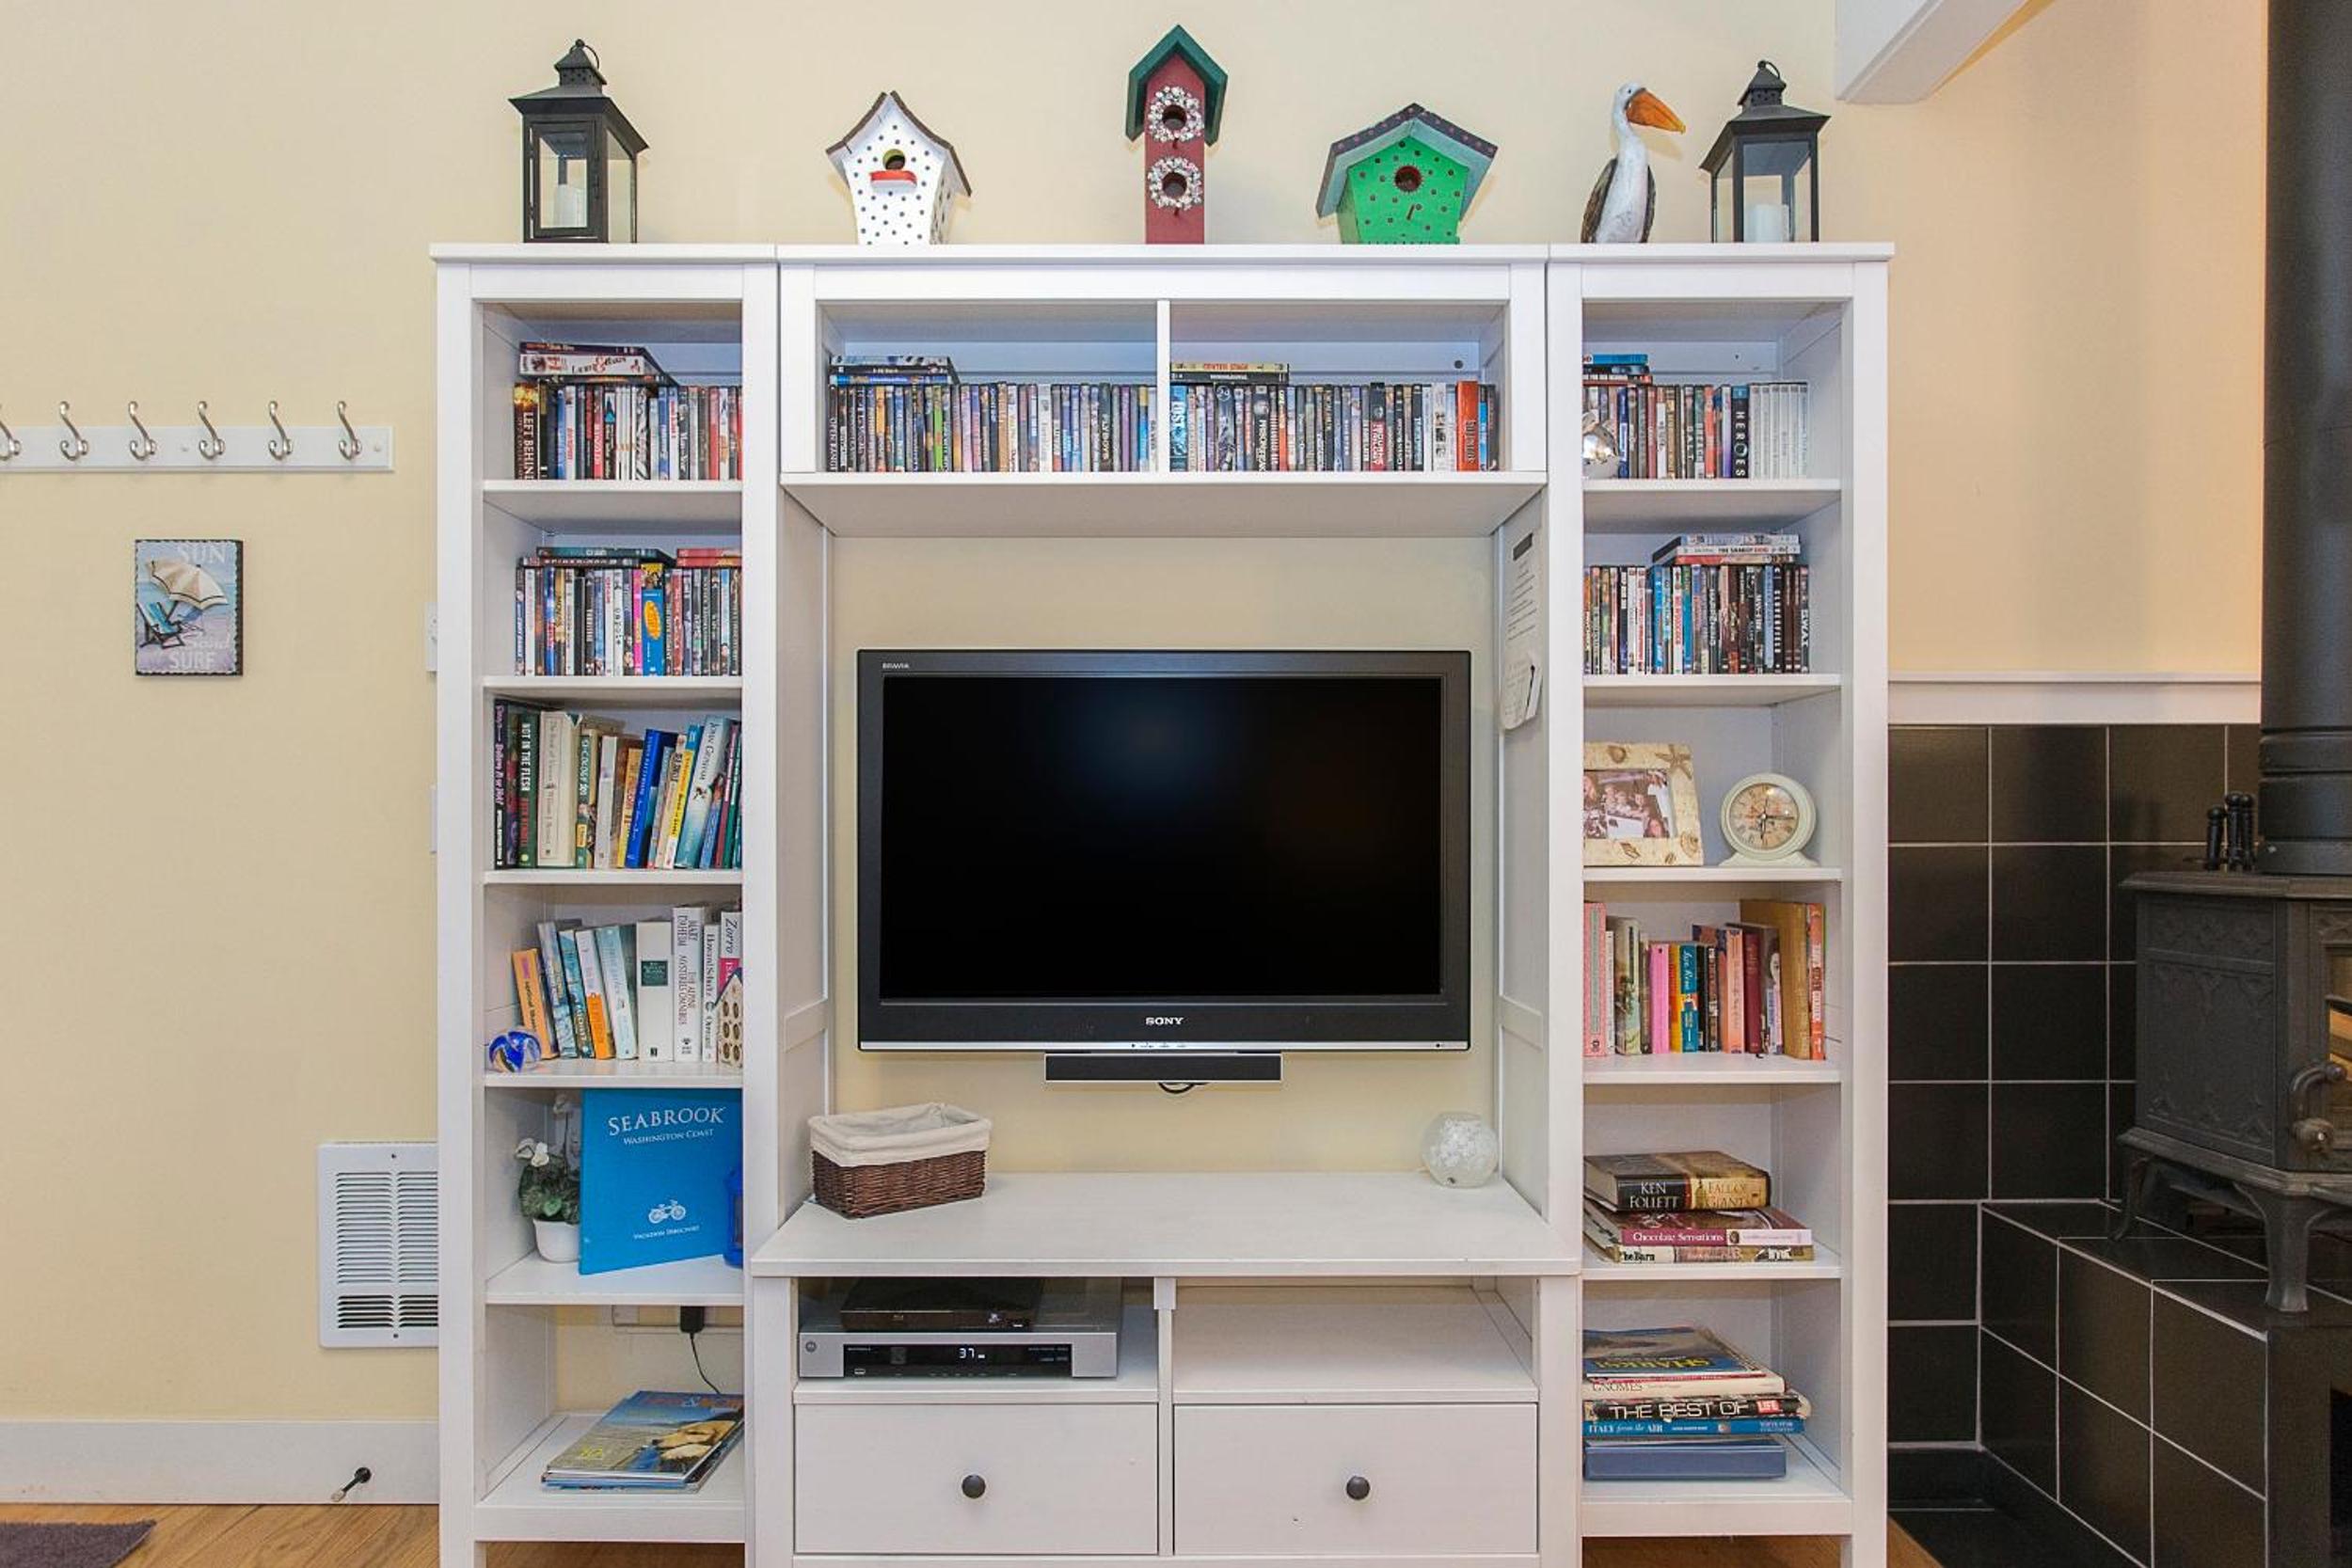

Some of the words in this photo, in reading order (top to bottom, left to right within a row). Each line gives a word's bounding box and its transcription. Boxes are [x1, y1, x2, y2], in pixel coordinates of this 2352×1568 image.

[1171, 401, 1186, 429] LOST
[523, 412, 534, 437] LEFT
[1259, 420, 1267, 449] PRISON
[1734, 411, 1748, 477] HEROES
[177, 545, 226, 563] SUN
[168, 652, 215, 671] SURF
[521, 723, 531, 738] NOT
[707, 722, 720, 743] JOHN
[521, 751, 531, 767] THE
[521, 768, 531, 791] FLESH
[677, 915, 688, 946] DAHEIM
[688, 920, 697, 941] MARY
[724, 918, 738, 956] Zorro
[678, 955, 688, 991] MYSTERIES
[1145, 1017, 1184, 1025] SONY
[608, 1106, 727, 1136] SEABROOK
[623, 1132, 685, 1146] WASHINGTON
[686, 1128, 714, 1140] COAST
[1641, 1180, 1667, 1196] KEN
[1629, 1196, 1680, 1209] FOLLETT
[1632, 1231, 1676, 1243] Chocolate
[1677, 1232, 1724, 1243] Sensations
[959, 1347, 976, 1358] 37
[1592, 1383, 1644, 1392] GNOMES
[1609, 1404, 1653, 1419] THE
[1659, 1402, 1713, 1418] BEST
[1719, 1402, 1749, 1417] OF
[1756, 1401, 1780, 1413] LIFE
[1588, 1424, 1614, 1433] ITALY
[1647, 1424, 1663, 1433] AIR
